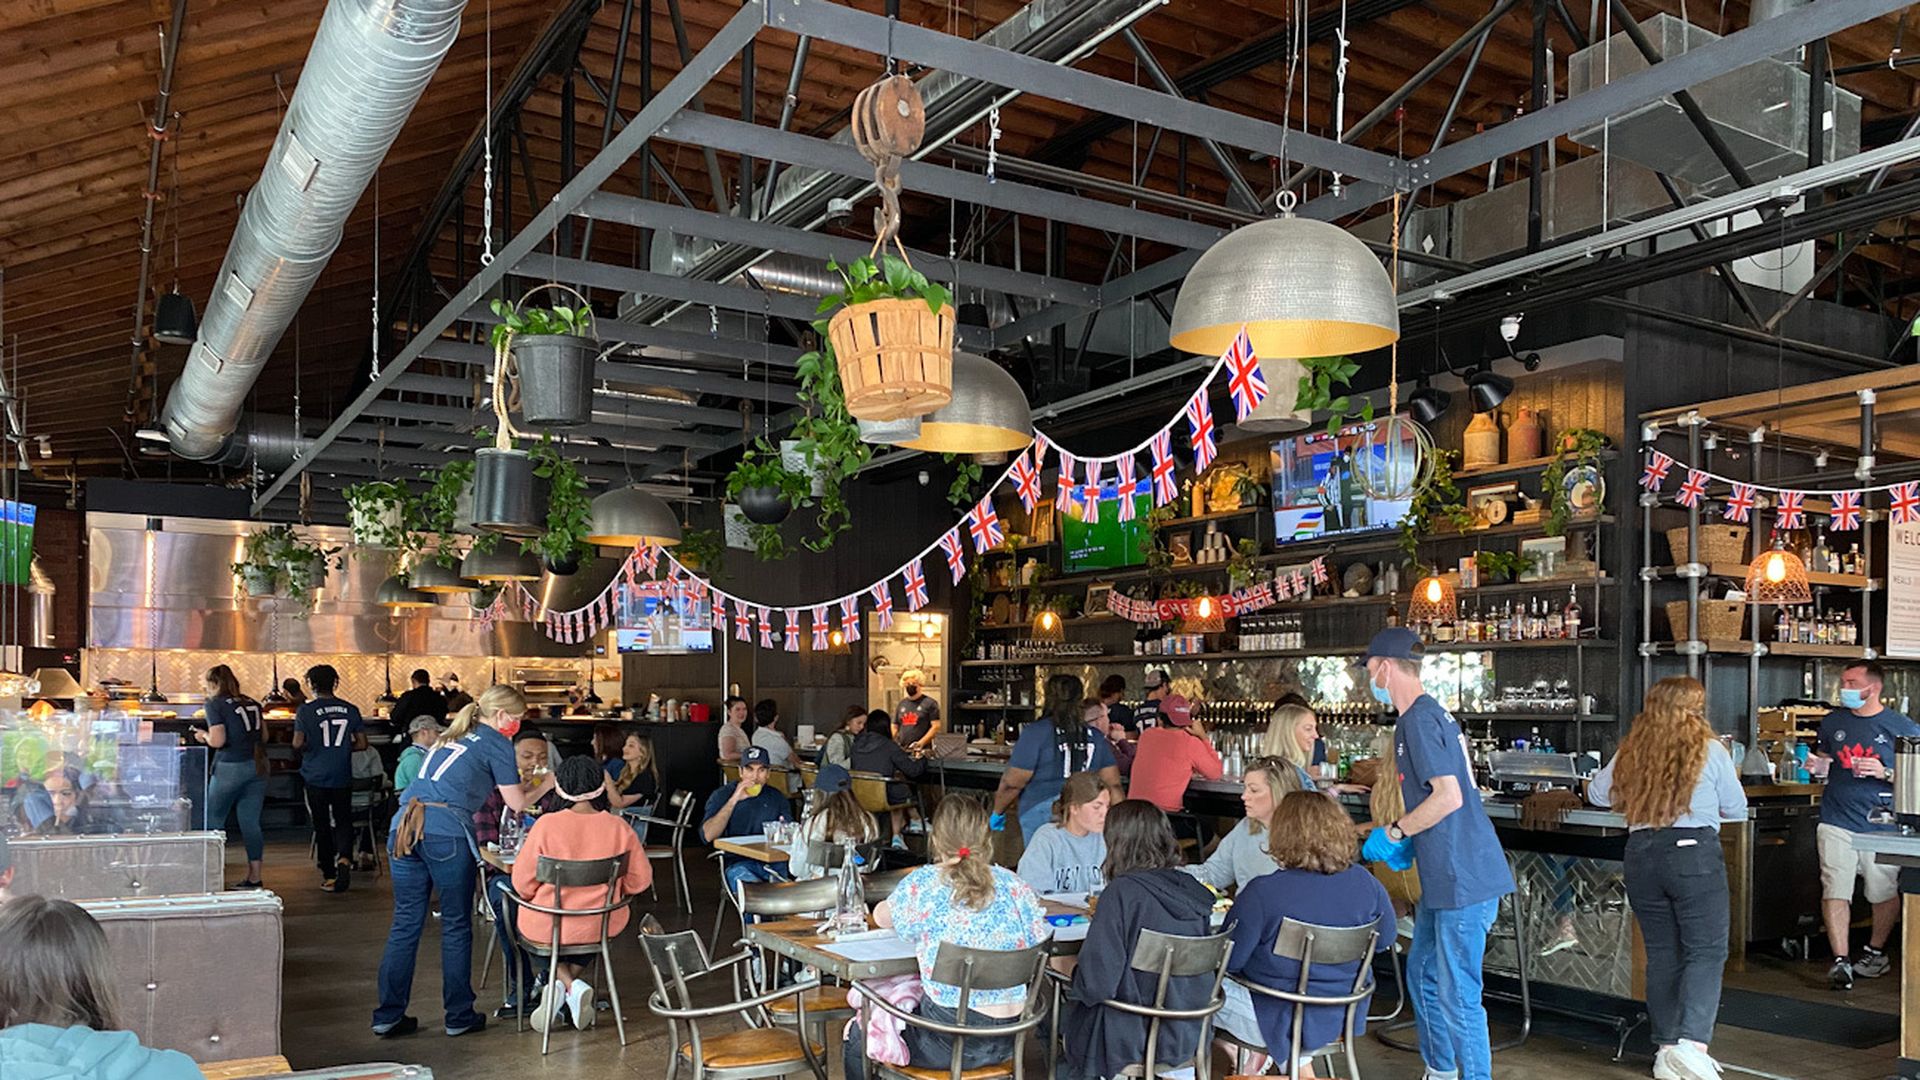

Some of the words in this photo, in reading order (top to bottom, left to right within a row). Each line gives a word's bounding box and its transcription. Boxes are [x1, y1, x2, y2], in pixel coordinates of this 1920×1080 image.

[235, 705, 261, 732] 17
[319, 719, 348, 747] 17
[418, 741, 468, 782] 17
